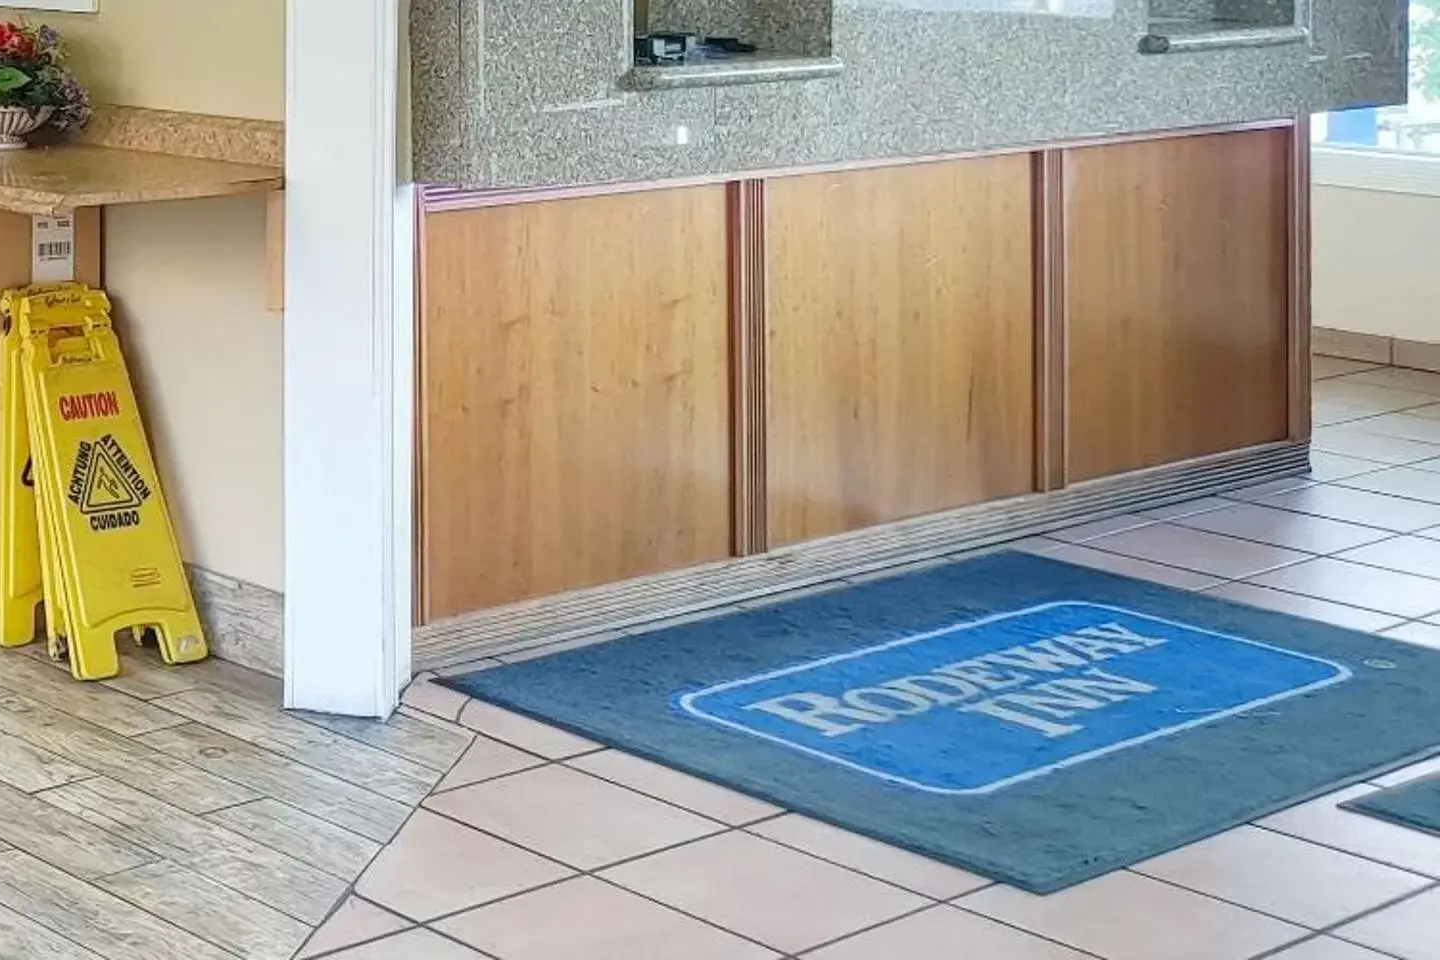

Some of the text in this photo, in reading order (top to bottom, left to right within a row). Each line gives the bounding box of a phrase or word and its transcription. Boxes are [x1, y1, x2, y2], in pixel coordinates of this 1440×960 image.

[59, 391, 120, 421] CAUTION
[67, 440, 92, 505] ACHTUNG
[101, 434, 151, 500] ATTENTION
[89, 510, 140, 531] CUIDADO
[742, 622, 1170, 737] RODEWAY
[958, 667, 1158, 738] INN
